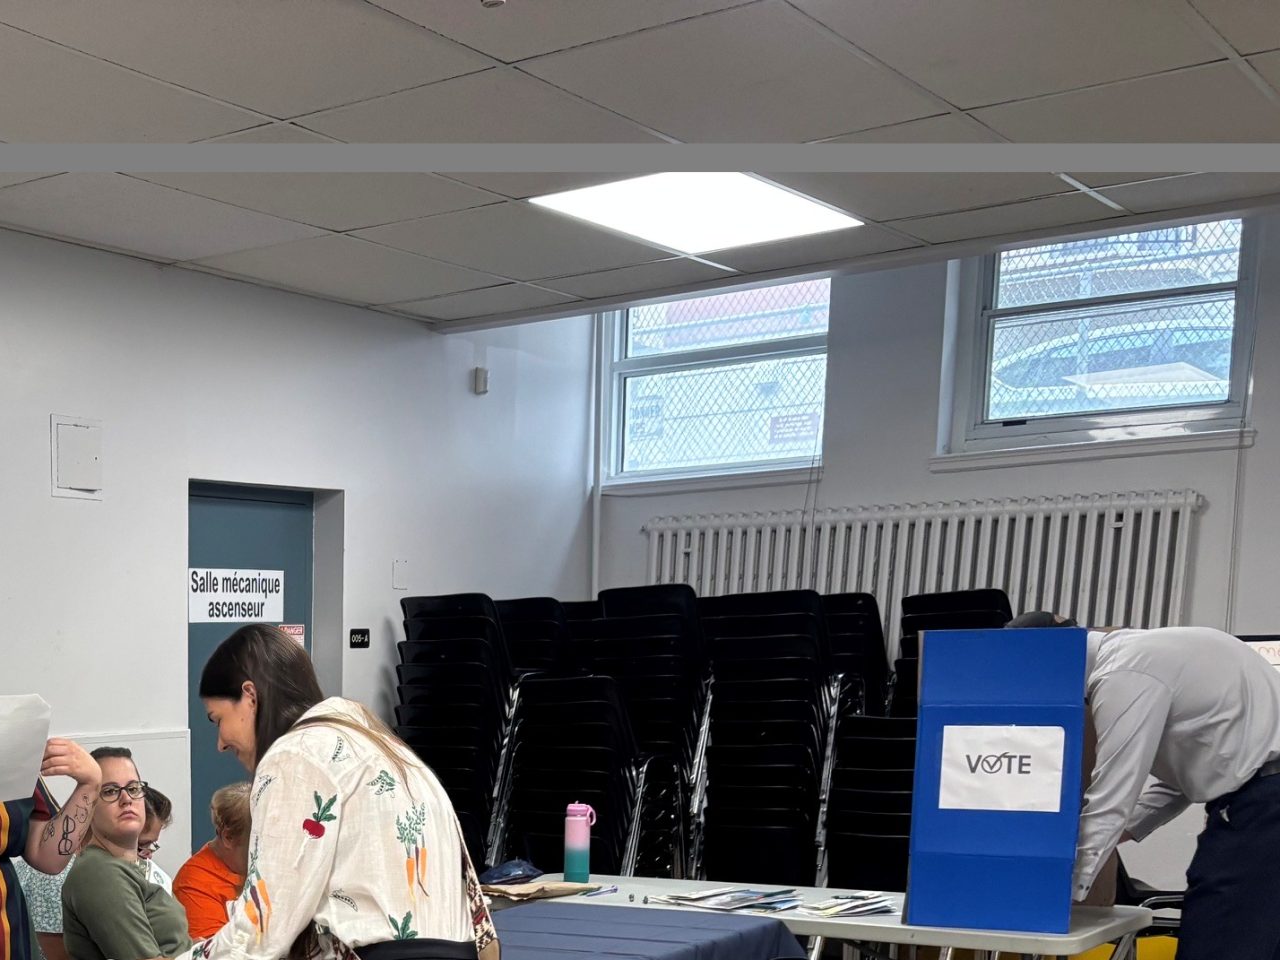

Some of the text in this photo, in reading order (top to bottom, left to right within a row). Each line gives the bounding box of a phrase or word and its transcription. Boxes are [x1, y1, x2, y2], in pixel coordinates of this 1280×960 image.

[191, 570, 281, 599] Salle mécanique
[208, 601, 265, 617] ascenseur
[966, 752, 1031, 774] VOTE
